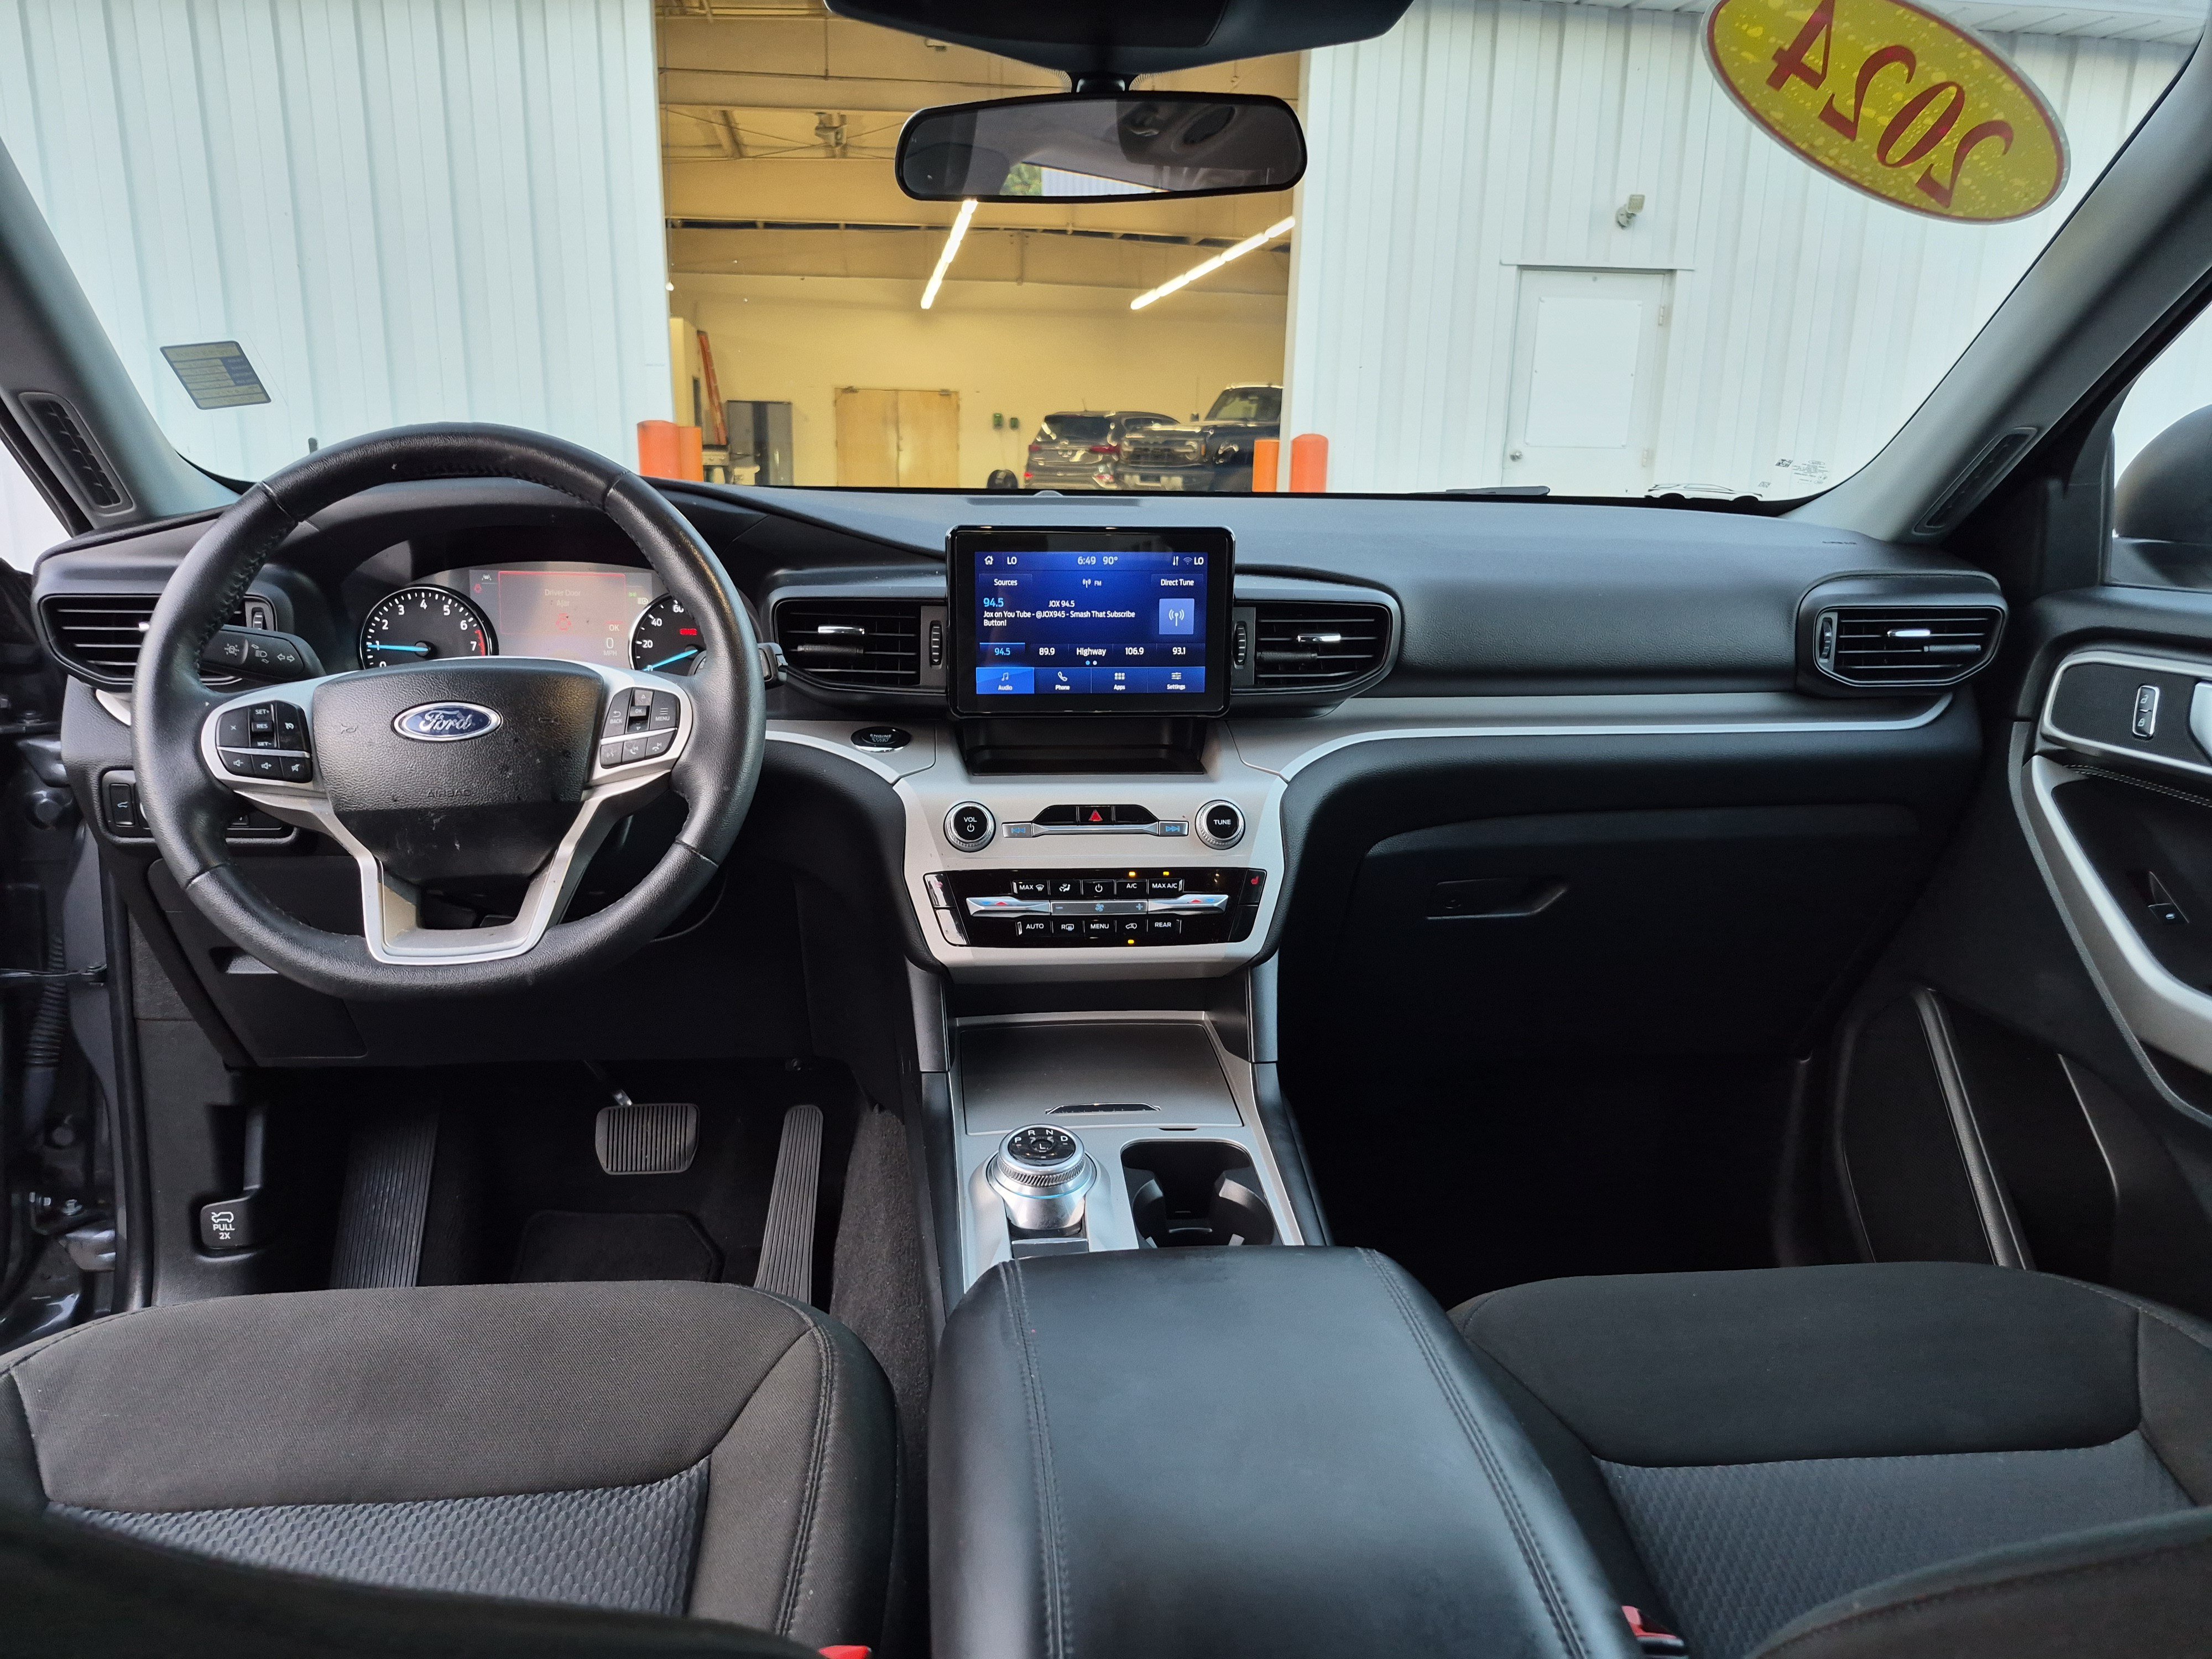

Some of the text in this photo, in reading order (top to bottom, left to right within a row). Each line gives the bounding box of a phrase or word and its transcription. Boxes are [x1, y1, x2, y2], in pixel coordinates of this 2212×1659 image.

[1006, 556, 1018, 565] LO
[1077, 556, 1097, 565] 6:49
[1194, 557, 1204, 565] LO
[420, 599, 427, 609] 4
[983, 598, 1004, 608] 94.5
[398, 605, 405, 615] 3
[444, 605, 451, 615] 5
[1036, 611, 1066, 619] @JOX945
[382, 619, 389, 630] 2
[460, 620, 468, 630] 6
[651, 618, 662, 627] 40
[470, 641, 477, 651] 7
[642, 639, 653, 648] 20
[1076, 647, 1107, 656] Highway
[419, 709, 473, 732] Ford
